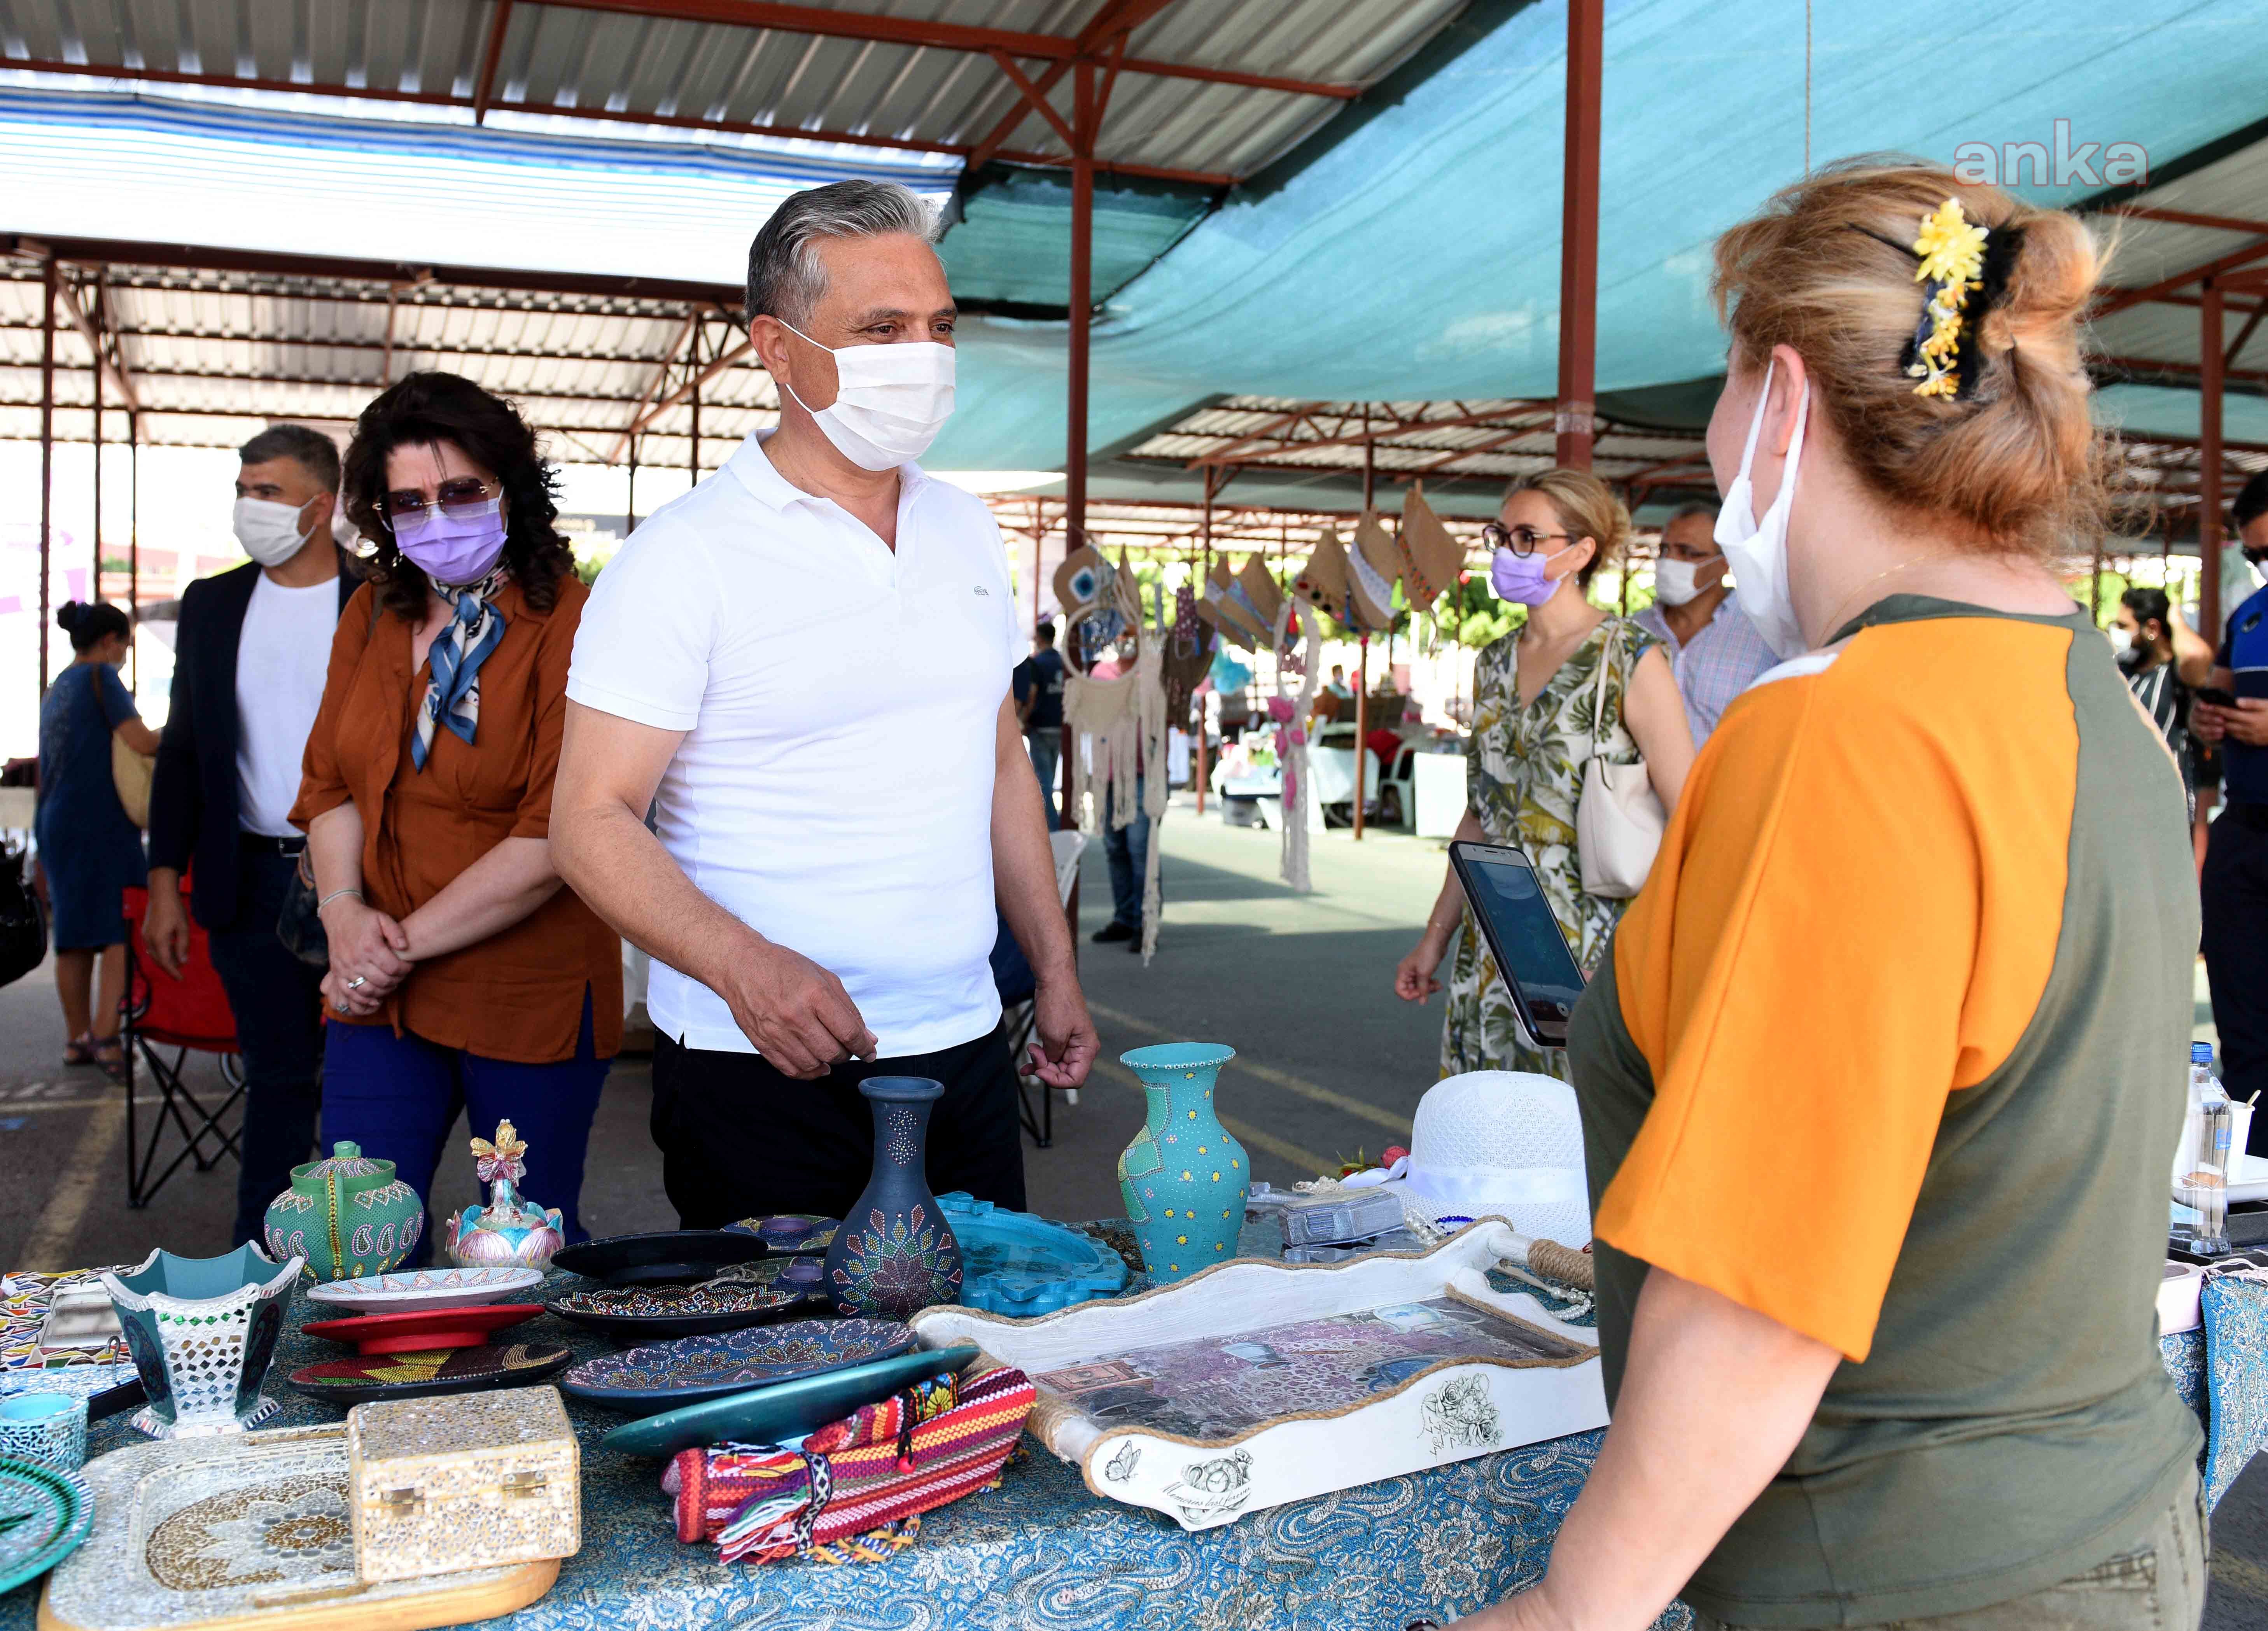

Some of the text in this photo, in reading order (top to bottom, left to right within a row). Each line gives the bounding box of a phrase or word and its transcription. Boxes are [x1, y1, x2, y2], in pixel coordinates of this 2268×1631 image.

[1177, 1378, 1230, 1392] FIRST
[1160, 1481, 1203, 1506] Memories
[1206, 1495, 1223, 1506] last
